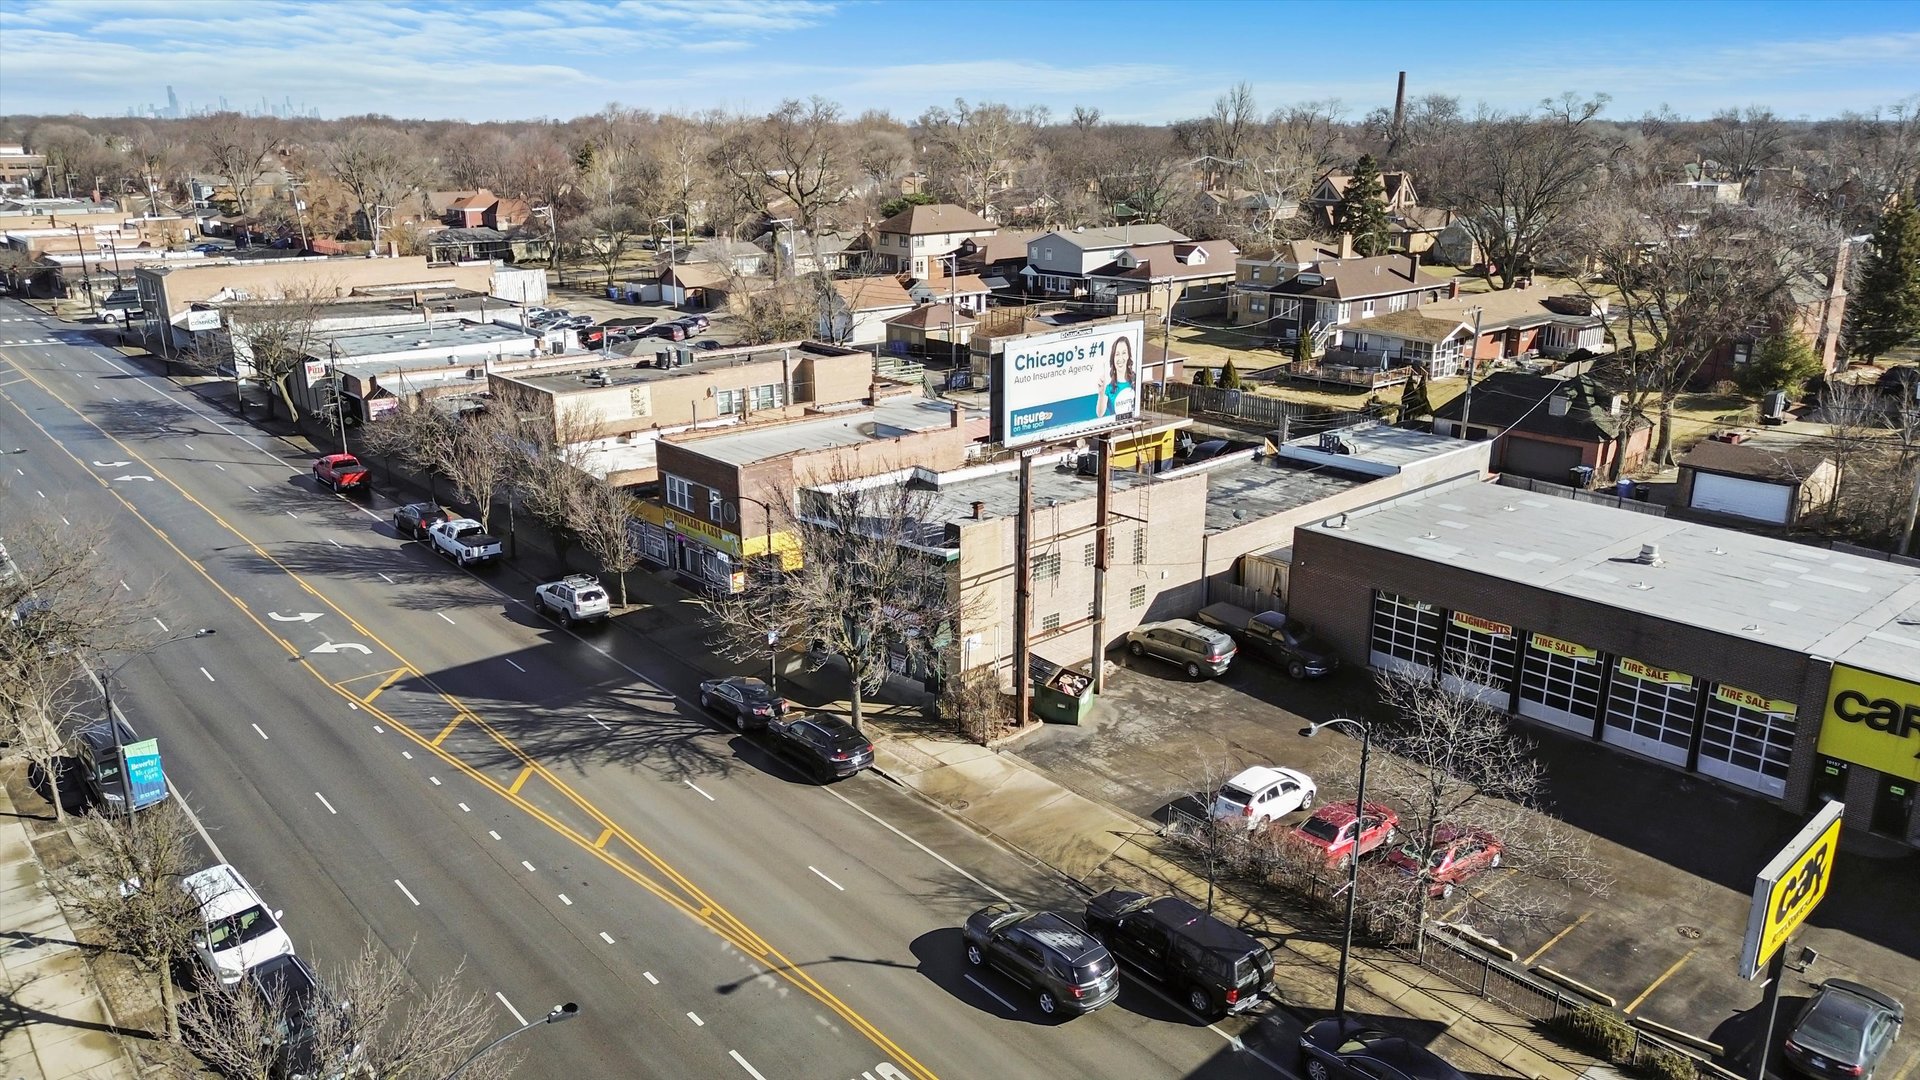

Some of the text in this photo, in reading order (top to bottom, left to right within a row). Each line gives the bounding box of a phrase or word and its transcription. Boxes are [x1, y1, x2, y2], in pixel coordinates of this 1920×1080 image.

[1015, 341, 1104, 371] Chicago's #1
[307, 365, 324, 374] PIZZA
[1014, 363, 1093, 384] Auto Insurance Agency
[1454, 613, 1511, 635] ALIGNMENTS
[1534, 636, 1576, 655] TIRE SALE
[1623, 661, 1669, 681] TIRE SALE
[1720, 687, 1770, 710] TIRE SALE
